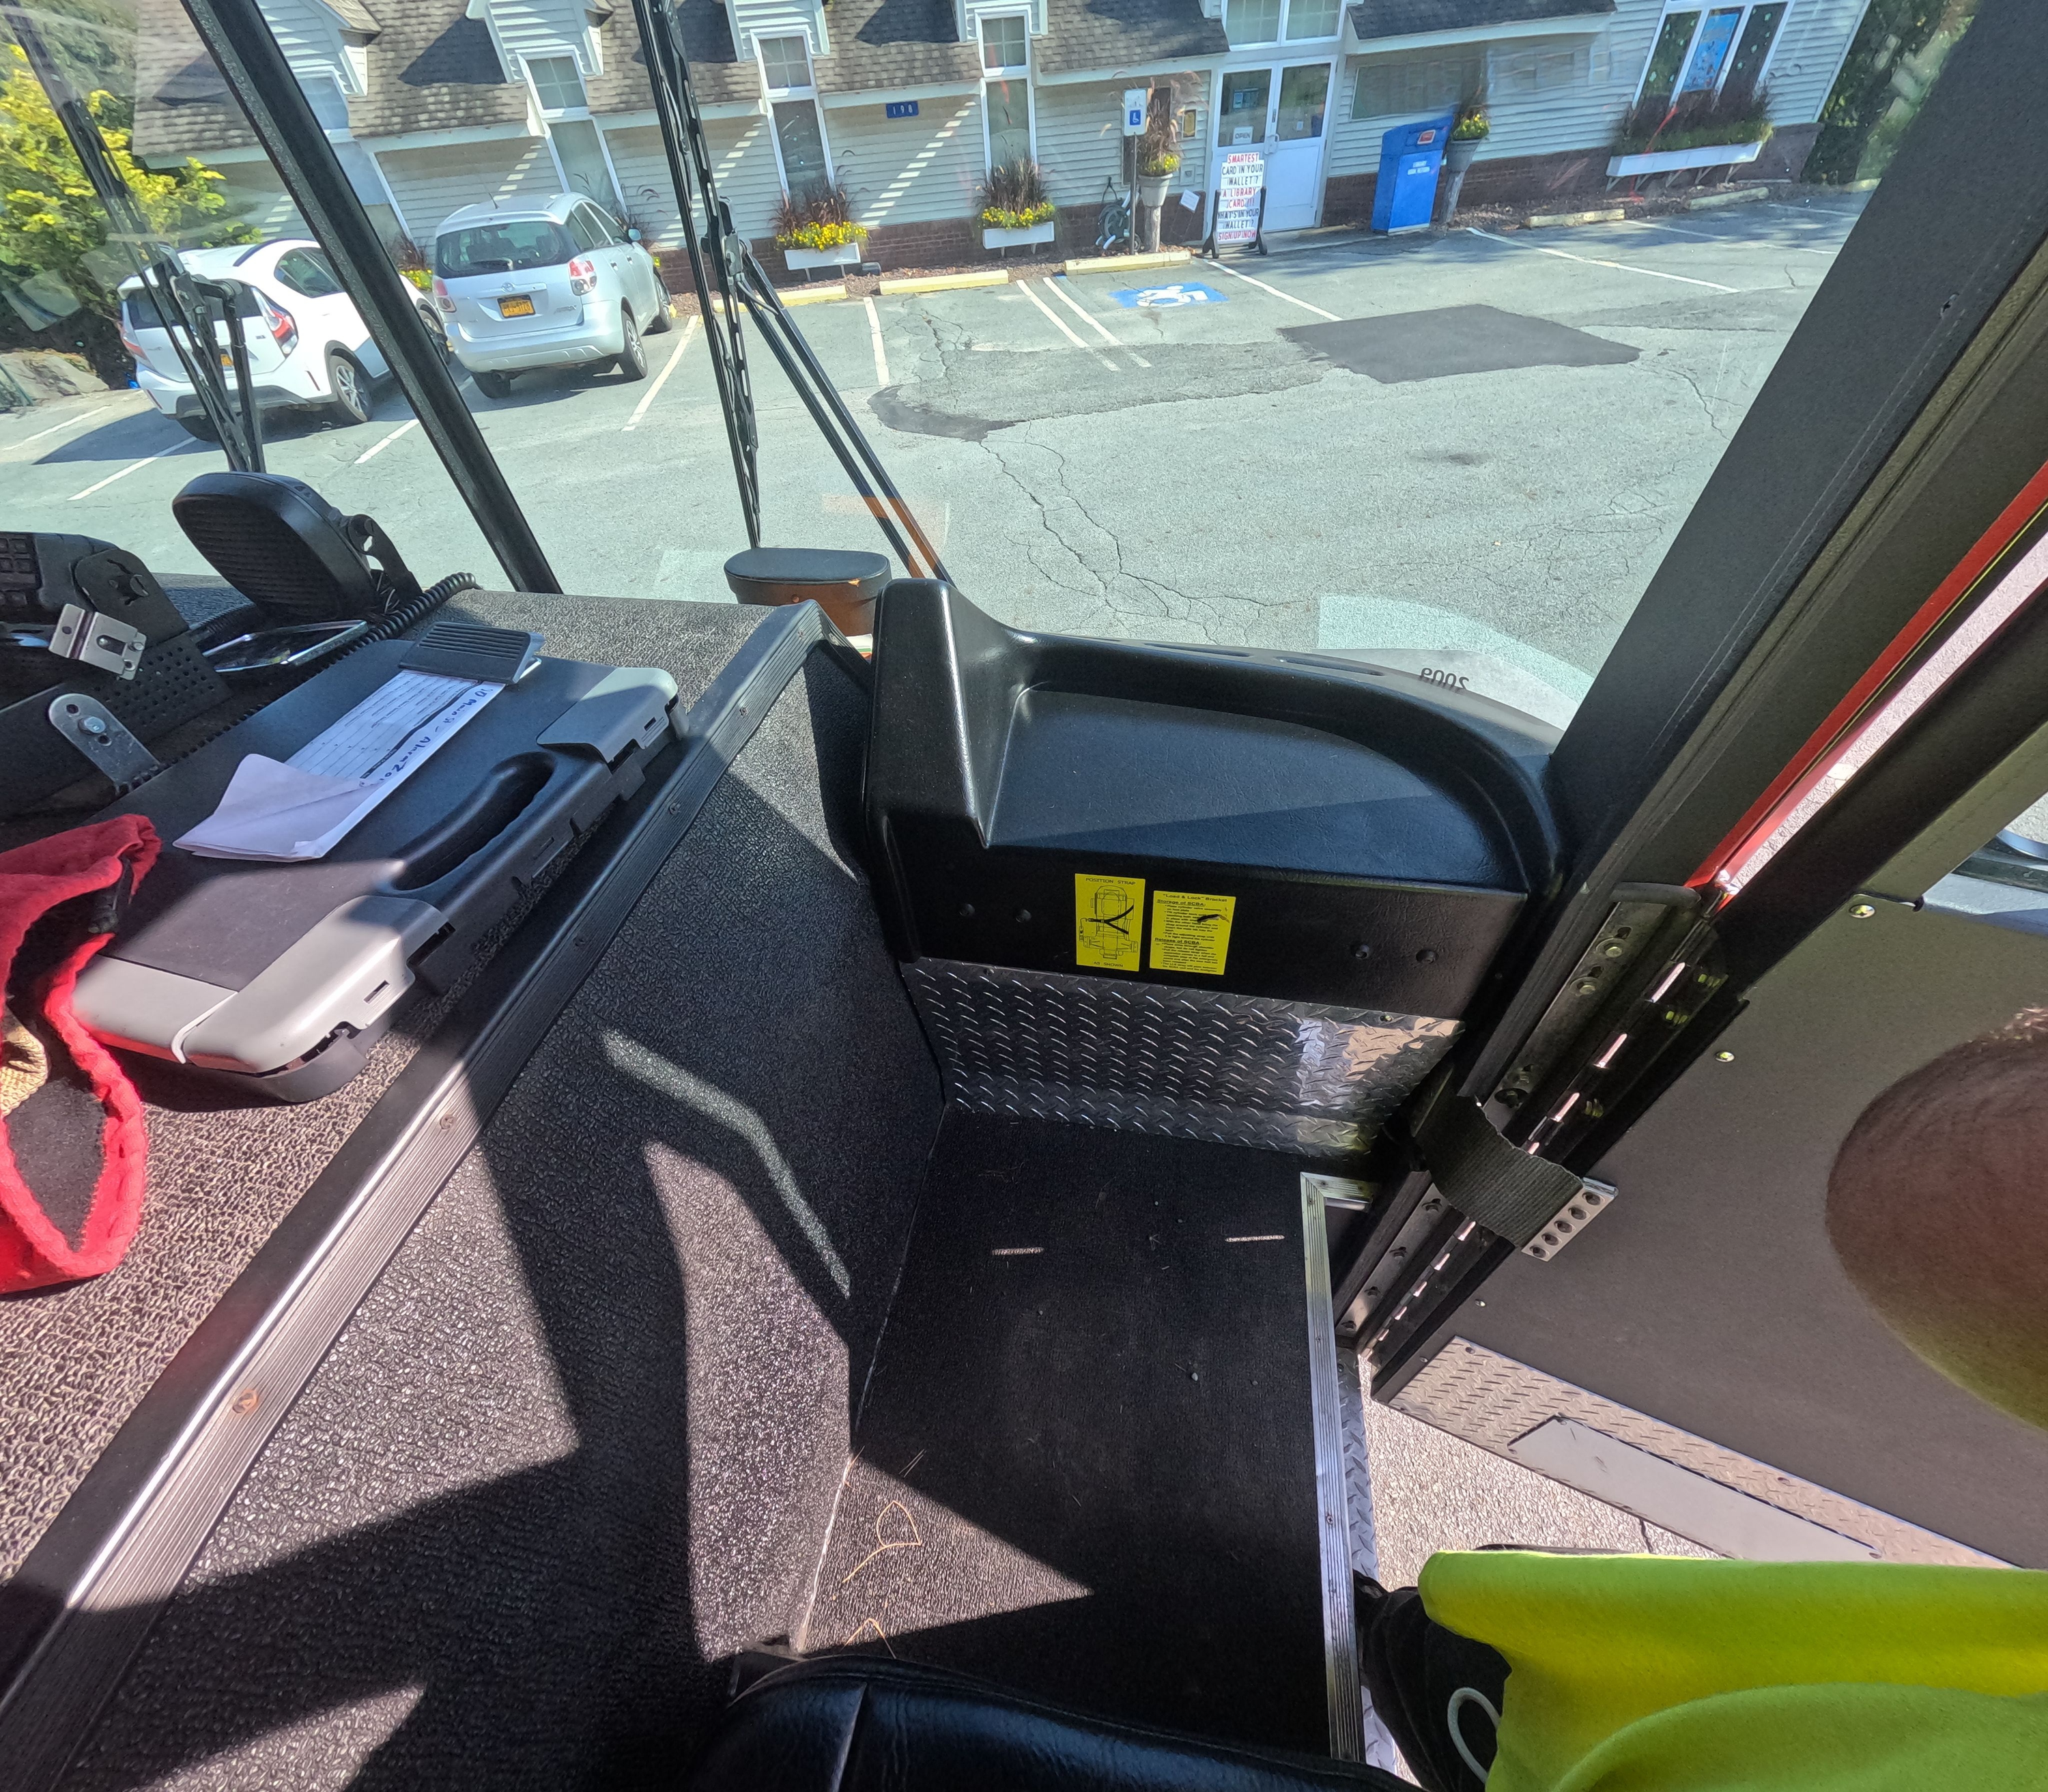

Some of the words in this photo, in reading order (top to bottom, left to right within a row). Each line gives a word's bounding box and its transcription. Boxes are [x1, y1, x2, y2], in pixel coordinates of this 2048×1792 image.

[1227, 153, 1259, 164] SMARTEST
[1222, 166, 1236, 175] CARD
[1239, 165, 1245, 174] IN
[1247, 164, 1263, 173] YOUR
[1229, 176, 1252, 186] WALLET
[1223, 189, 1227, 197] A
[1230, 187, 1256, 197] LIBRARY
[1229, 198, 1245, 208] CARD
[1246, 208, 1259, 218] YOUR
[1225, 220, 1249, 229] WALLET
[1219, 232, 1232, 240] SIGN
[1234, 231, 1241, 239] UP
